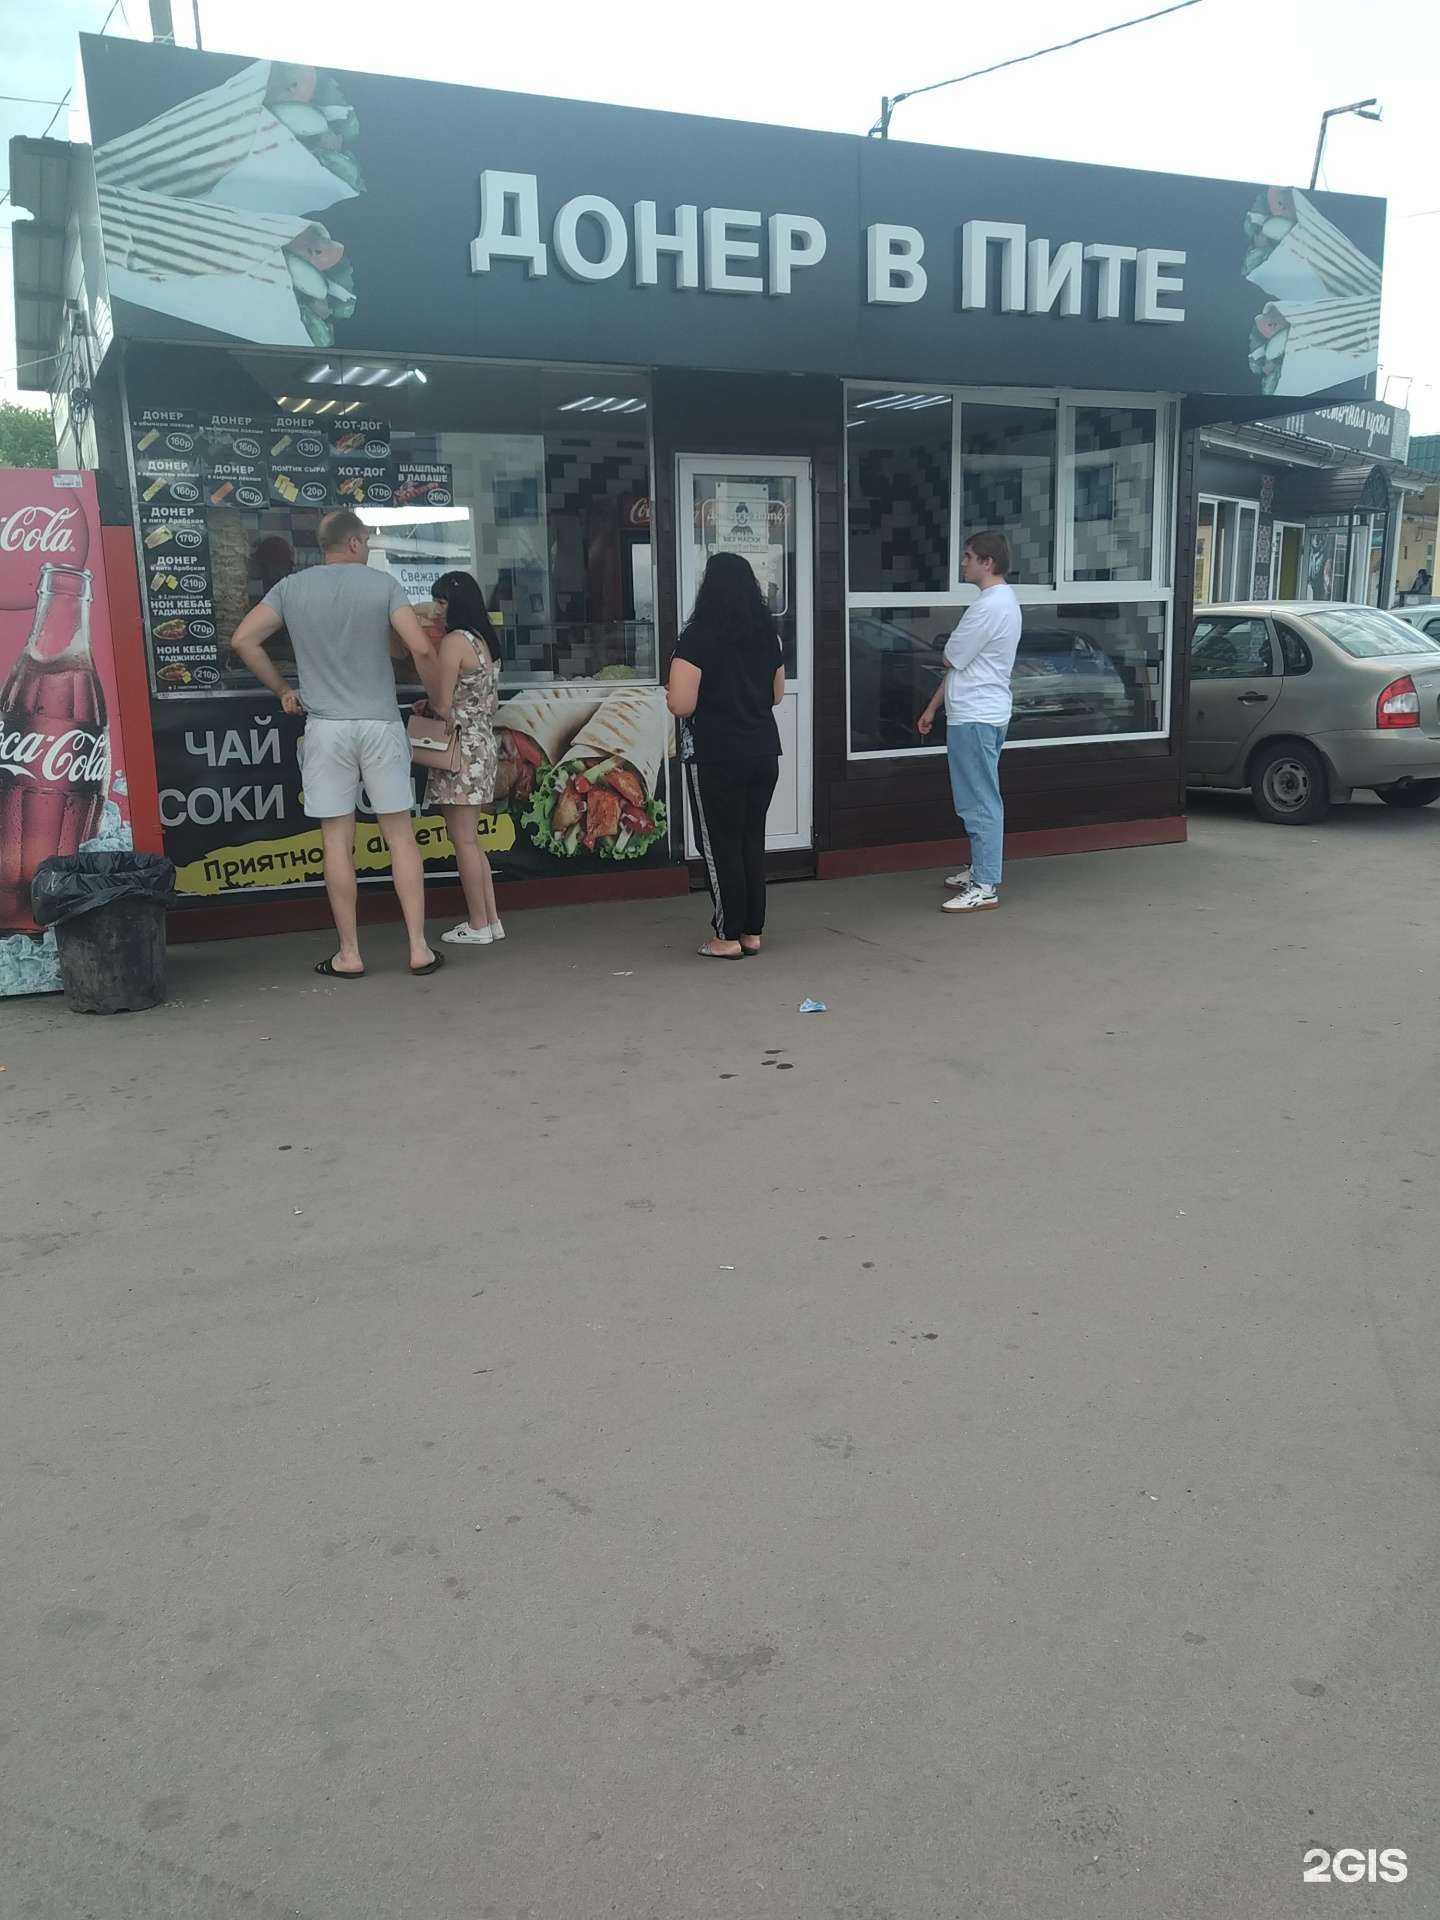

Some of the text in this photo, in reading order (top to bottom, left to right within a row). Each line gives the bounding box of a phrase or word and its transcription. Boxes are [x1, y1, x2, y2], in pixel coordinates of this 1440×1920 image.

[470, 169, 1187, 323] ДОНЕР В ПИТЕ
[143, 411, 184, 420] ДОНЕР
[211, 415, 252, 426] ДОНЕР
[277, 418, 314, 427] ДОНЕР
[334, 420, 383, 430] ХОТ-ДОГ
[147, 461, 188, 471] ДОНЕР
[214, 464, 254, 475] ДОНЕР
[272, 464, 326, 473] ЛОМТИК СЫРА
[400, 463, 446, 474] ШАШЛЫК
[337, 467, 386, 477] ХОТ-ДОГ
[407, 473, 448, 482] ЛАВАШЕ
[306, 486, 323, 498] 20р
[370, 487, 390, 499] 170р
[151, 507, 194, 517] ДОНЕР
[179, 533, 200, 544] 170р
[157, 556, 198, 566] ДОНЕР
[183, 578, 204, 589] 210р
[150, 600, 212, 609] НОН КЕБАБ
[152, 608, 212, 616] ТАДЖИКСКАЯ
[192, 624, 212, 635] 170р
[156, 645, 217, 655] НОН КЕБАБ
[160, 654, 217, 662] ТАДЖИКСКАЯ
[184, 715, 282, 767] ЧАЙ
[158, 784, 286, 828] СОКИ
[203, 845, 356, 888] Приятно
